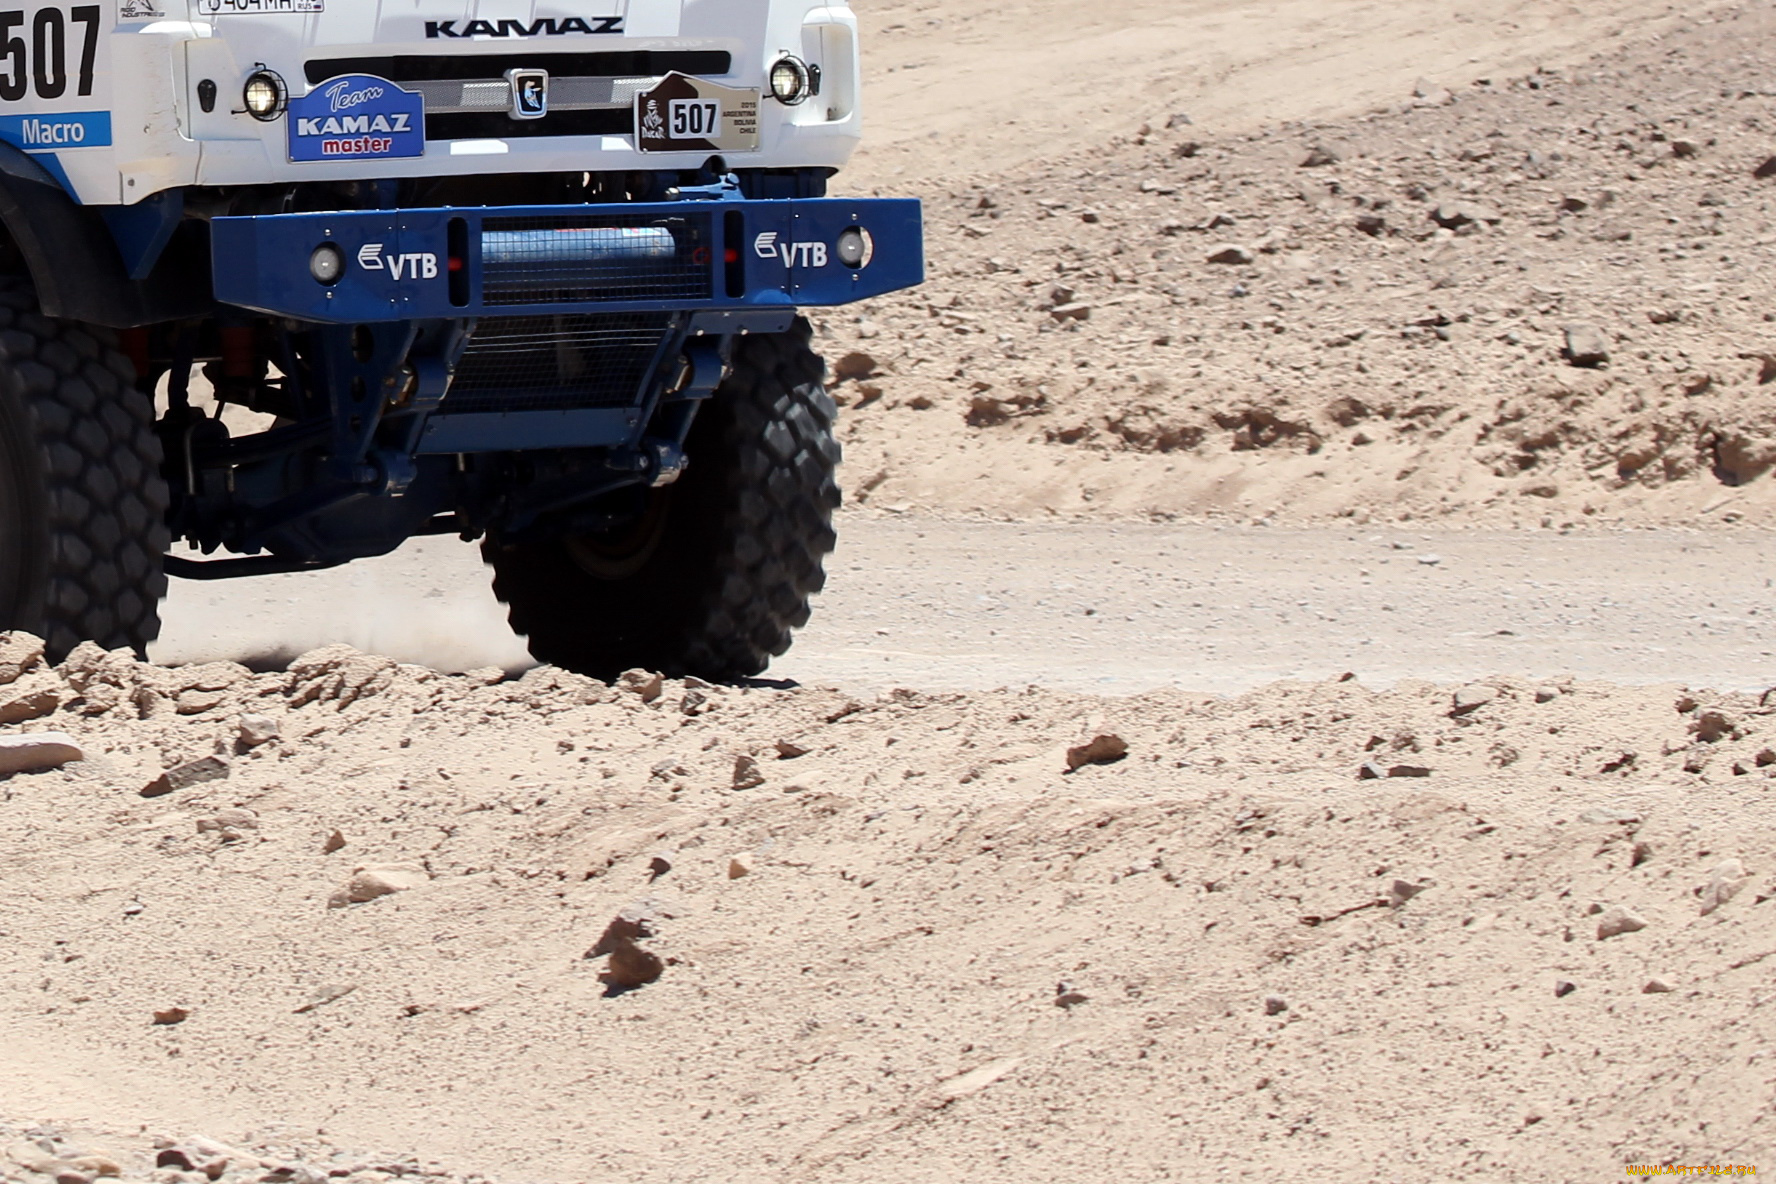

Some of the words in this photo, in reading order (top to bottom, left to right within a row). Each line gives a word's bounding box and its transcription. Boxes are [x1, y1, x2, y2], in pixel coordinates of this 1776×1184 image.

[425, 16, 624, 39] KAMAZ
[326, 81, 384, 112] Team
[297, 114, 411, 136] KAMAZ
[674, 103, 717, 134] 507
[22, 119, 84, 144] Macro
[323, 136, 392, 155] master
[386, 253, 438, 281] VTB
[780, 242, 827, 268] VTB
